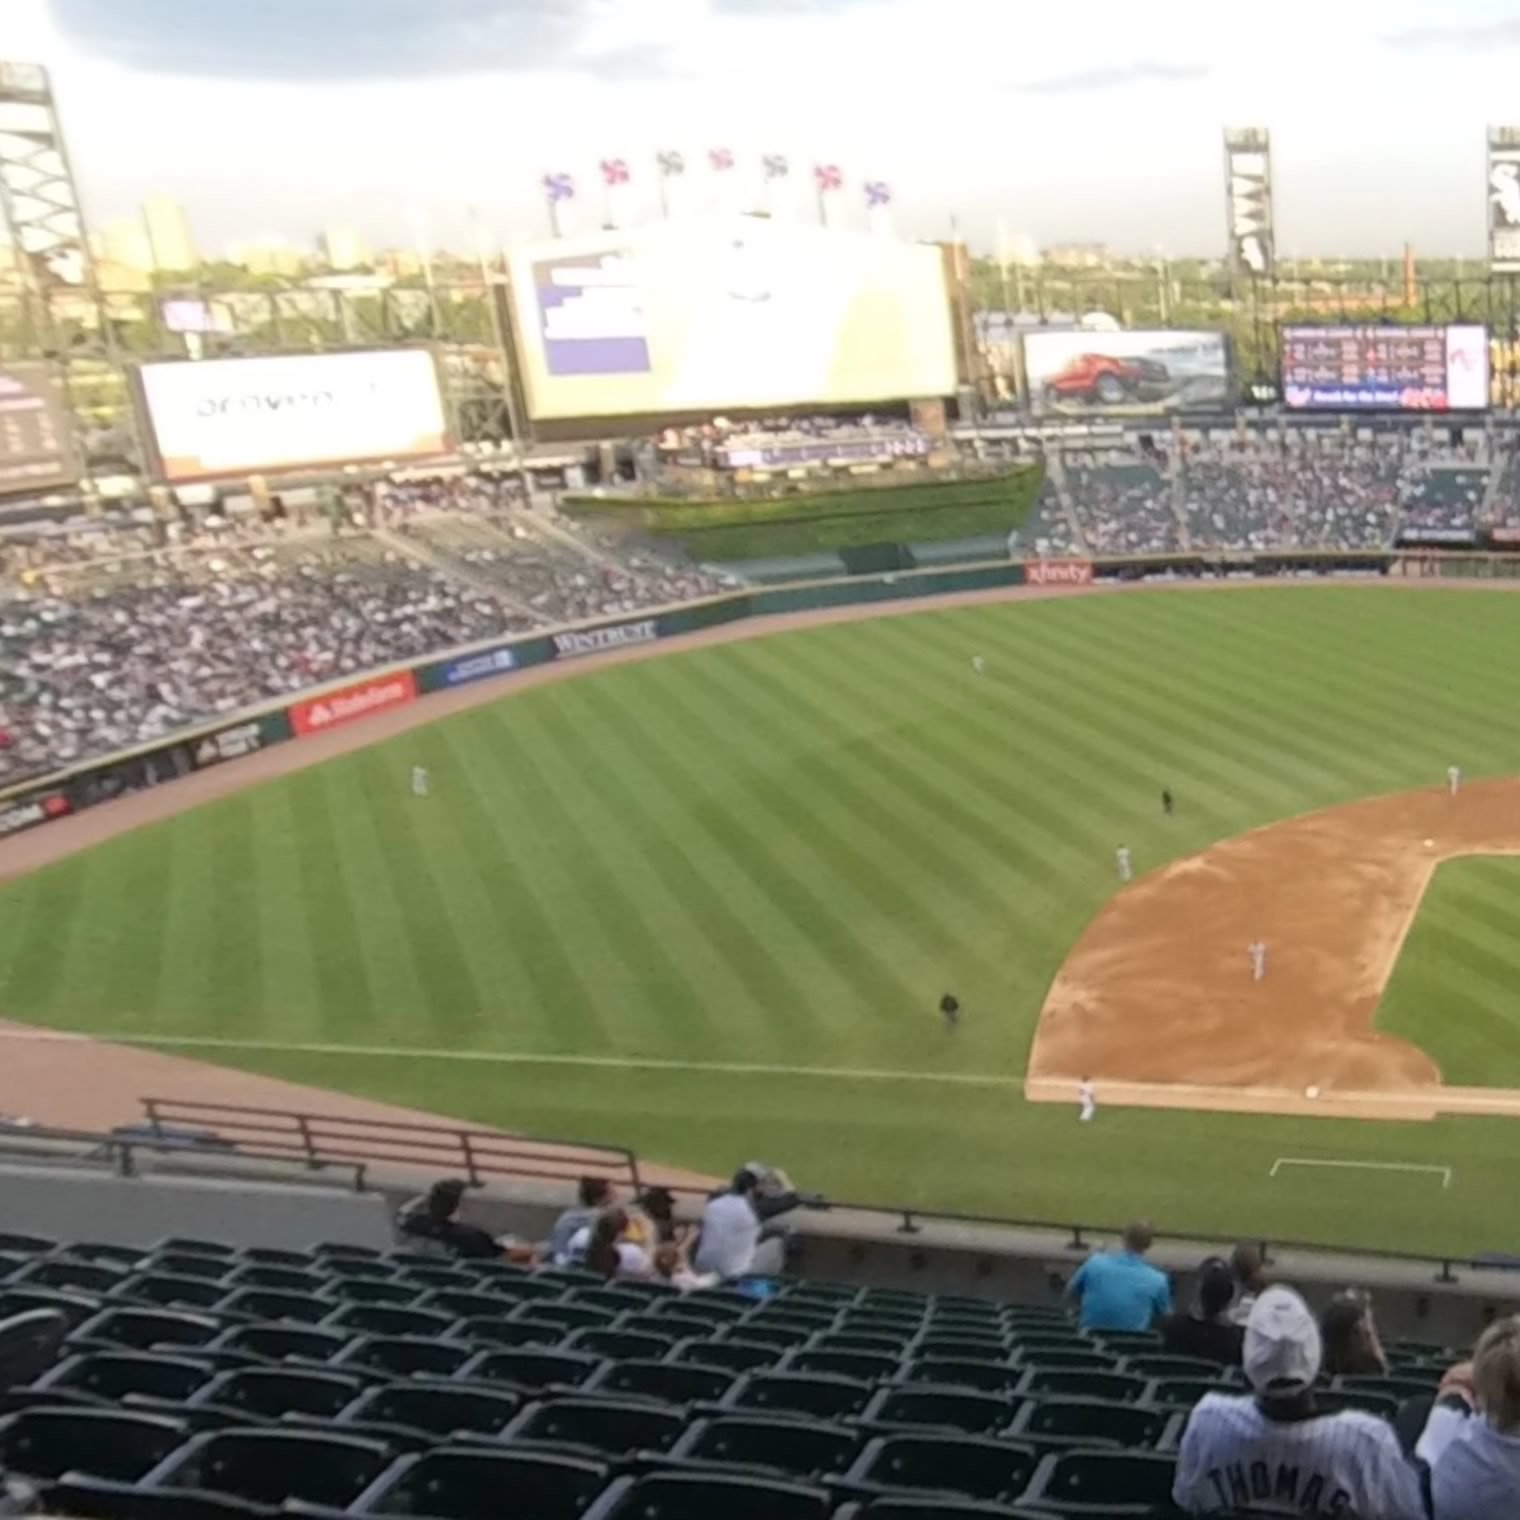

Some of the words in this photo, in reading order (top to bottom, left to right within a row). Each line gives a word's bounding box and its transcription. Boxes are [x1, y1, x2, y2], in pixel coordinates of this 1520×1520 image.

[1027, 561, 1090, 584] xfinity
[552, 620, 657, 659] WINTRUST
[1207, 1460, 1354, 1516] THOMAS
